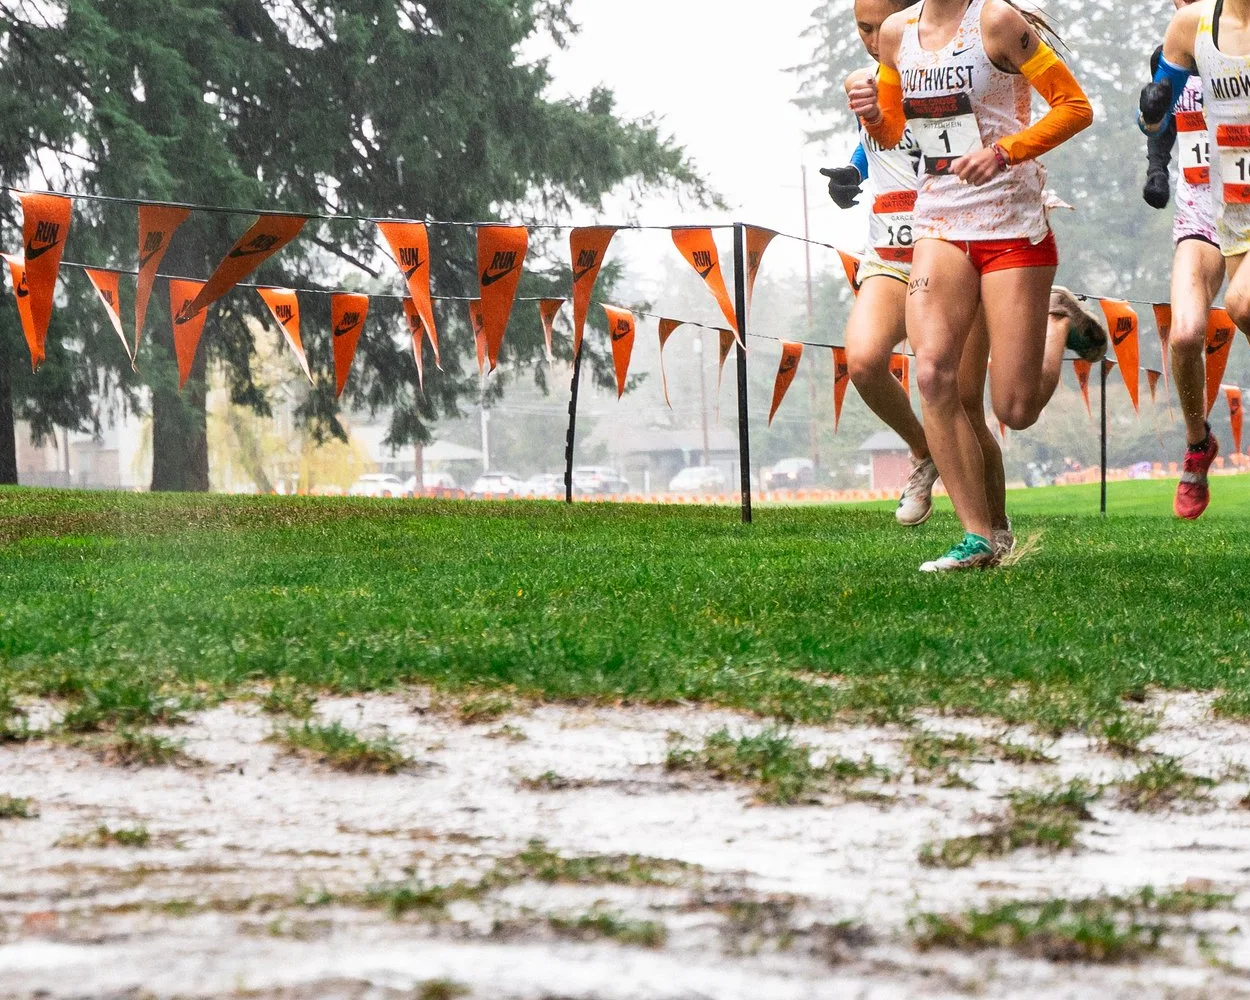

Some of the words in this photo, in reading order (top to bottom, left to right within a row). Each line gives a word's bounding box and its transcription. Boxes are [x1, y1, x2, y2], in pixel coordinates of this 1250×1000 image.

[902, 65, 974, 93] OUTHWEST
[938, 130, 951, 153] 1
[34, 220, 60, 243] RUN
[888, 225, 913, 246] 16
[398, 248, 419, 267] RUN
[490, 251, 517, 270] RUN
[577, 249, 598, 268] RUN
[692, 251, 712, 268] RUN
[275, 305, 292, 318] RUN
[341, 312, 360, 325] RUN
